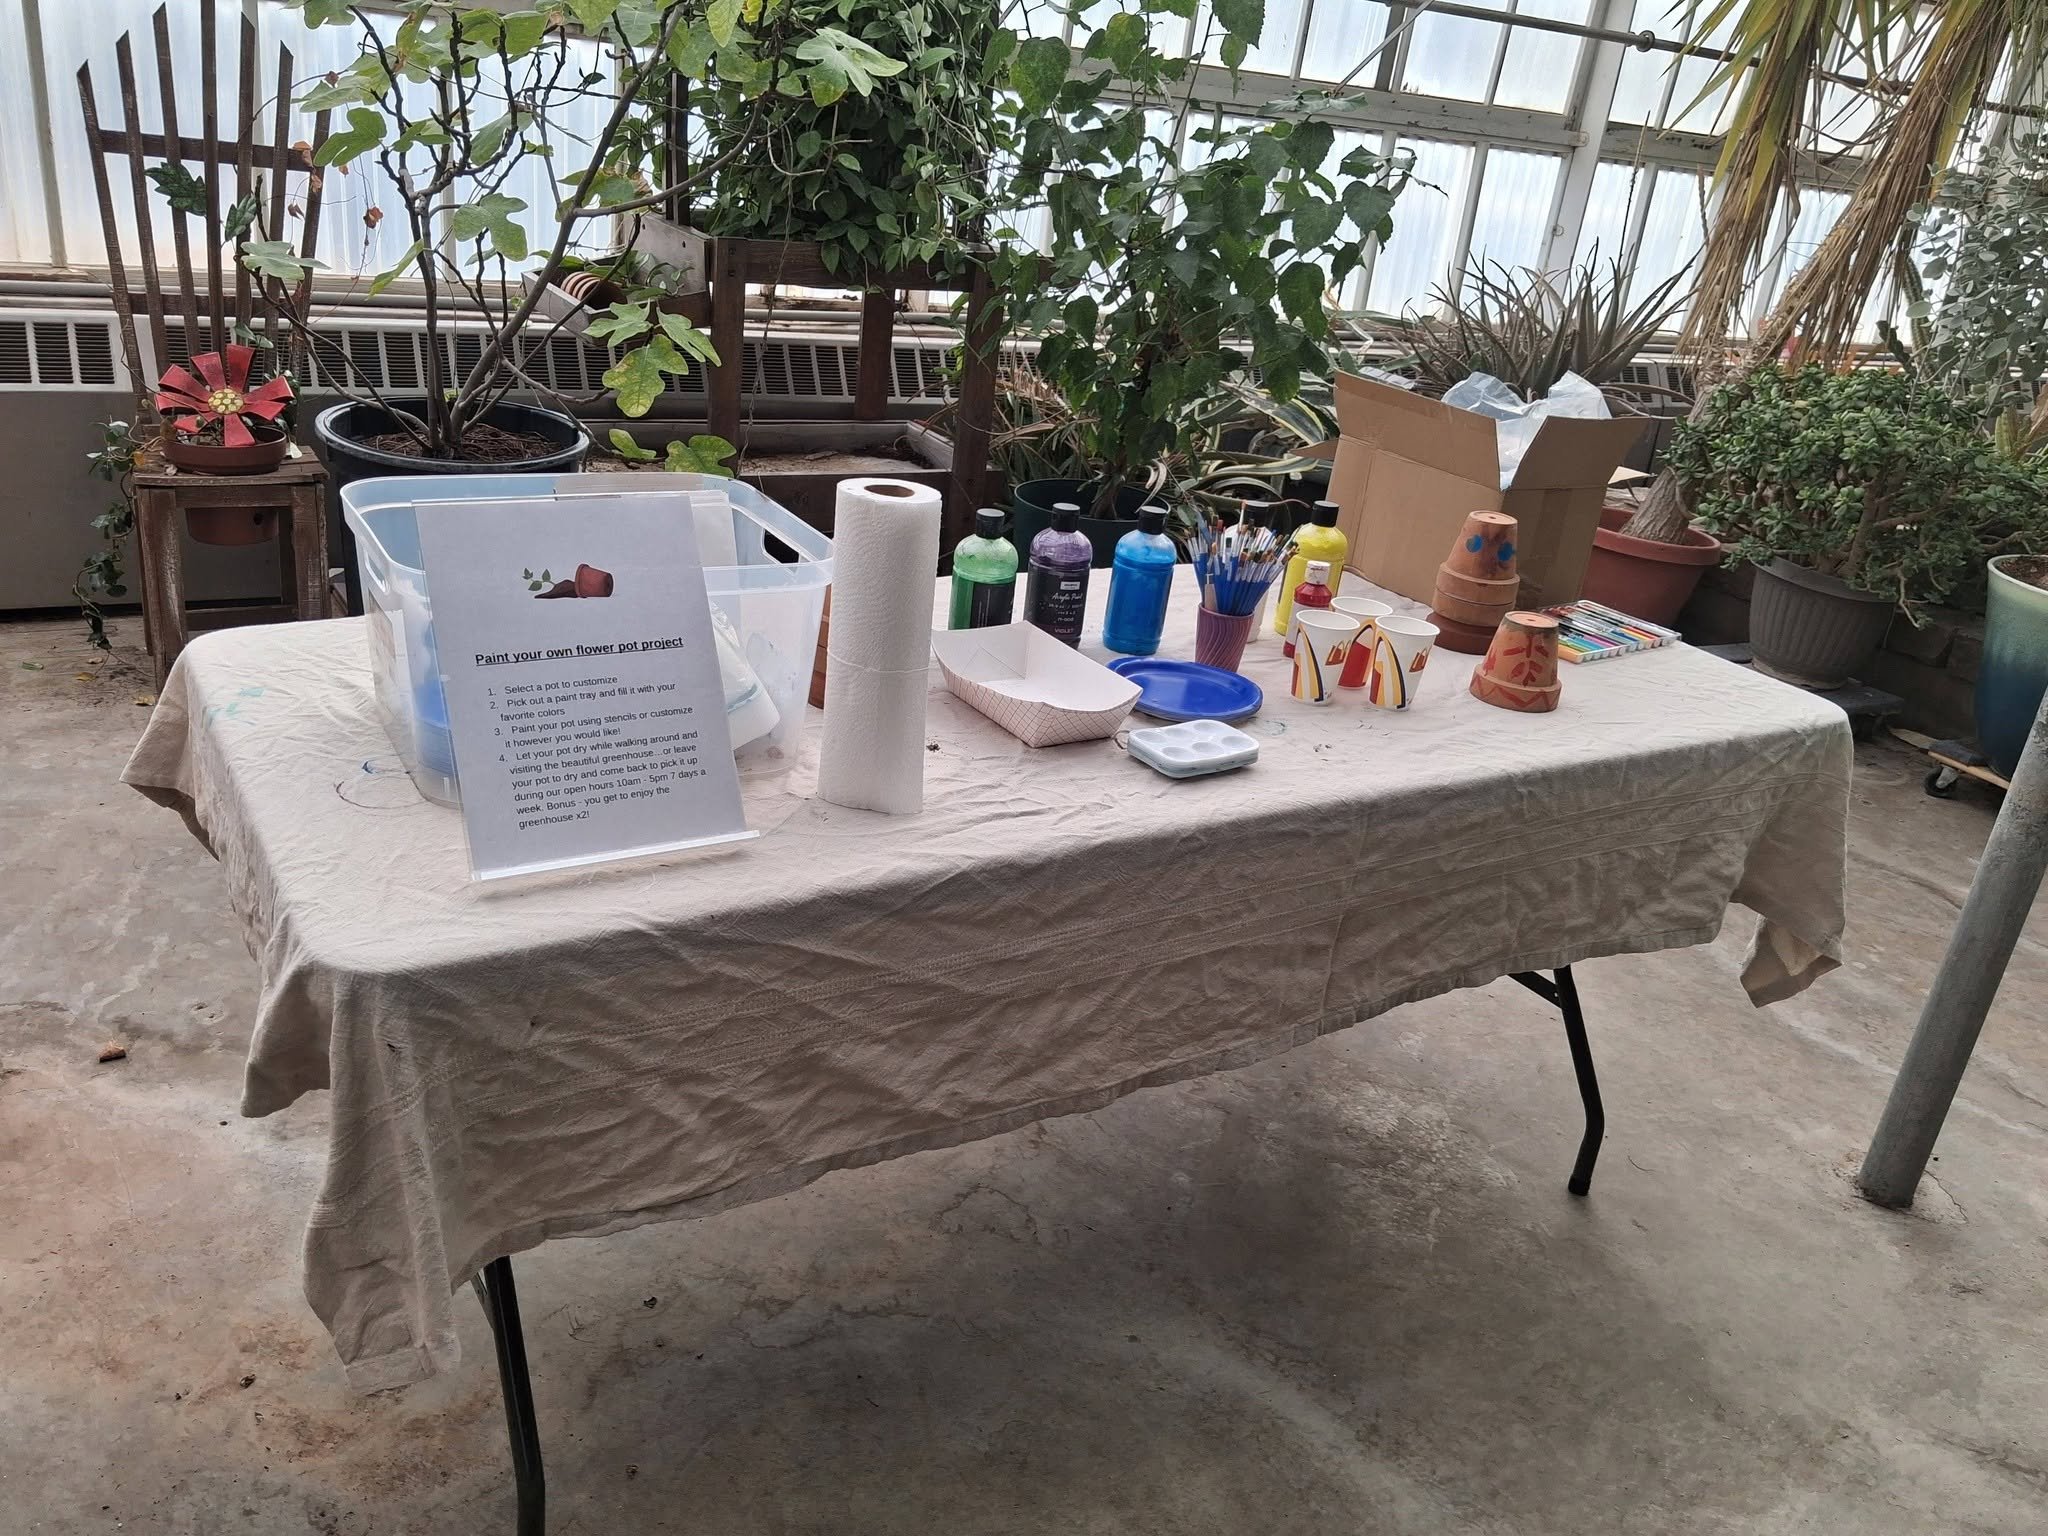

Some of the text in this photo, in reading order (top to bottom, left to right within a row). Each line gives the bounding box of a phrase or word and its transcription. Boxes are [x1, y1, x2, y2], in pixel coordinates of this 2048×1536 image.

[475, 636, 684, 664] Paint your own flower pot project
[487, 687, 496, 696] 1.
[504, 684, 534, 694] Select
[544, 682, 560, 691] pot
[572, 676, 618, 687] customize
[489, 701, 498, 709] 2.
[506, 697, 527, 707] Pick
[529, 696, 544, 705] out
[554, 693, 577, 704] paint
[579, 692, 596, 701] tray
[598, 688, 616, 698] and
[617, 687, 628, 695] fill
[636, 684, 655, 693] with
[656, 683, 675, 693] your
[494, 727, 503, 736] 3.
[511, 724, 536, 734] Paint
[537, 722, 557, 733] your
[560, 719, 575, 730] pot
[577, 716, 602, 726] using
[603, 712, 637, 723] stencils
[650, 707, 693, 718] customize
[500, 708, 565, 722] favorite colors
[498, 730, 698, 762] 4. Let your pot dry while walking around and
[504, 727, 621, 748] it however you would like!
[509, 764, 542, 775] visiting
[544, 761, 559, 770] the
[561, 755, 600, 768] beautiful
[673, 744, 696, 753] leave
[511, 779, 532, 790] your
[535, 776, 550, 786] pot
[551, 775, 561, 783] to
[563, 772, 578, 782] dry
[580, 769, 598, 779] and
[599, 767, 624, 776] come
[626, 762, 648, 773] back
[659, 758, 678, 770] pick
[679, 757, 685, 765] it
[686, 757, 698, 766] up
[514, 791, 544, 802] during
[545, 788, 560, 797] our
[563, 785, 587, 795] open
[588, 781, 614, 791] hours
[616, 778, 641, 787] 10am
[648, 774, 668, 784] 5pm
[670, 771, 675, 779] 7
[678, 770, 699, 779] days
[515, 804, 544, 814] week.
[546, 800, 576, 810] Bonus
[583, 796, 601, 807] you
[603, 793, 618, 804] get
[619, 792, 628, 800] to
[630, 789, 654, 799] enjoy
[655, 786, 670, 794] the
[518, 810, 590, 830] greenhouse x2!
